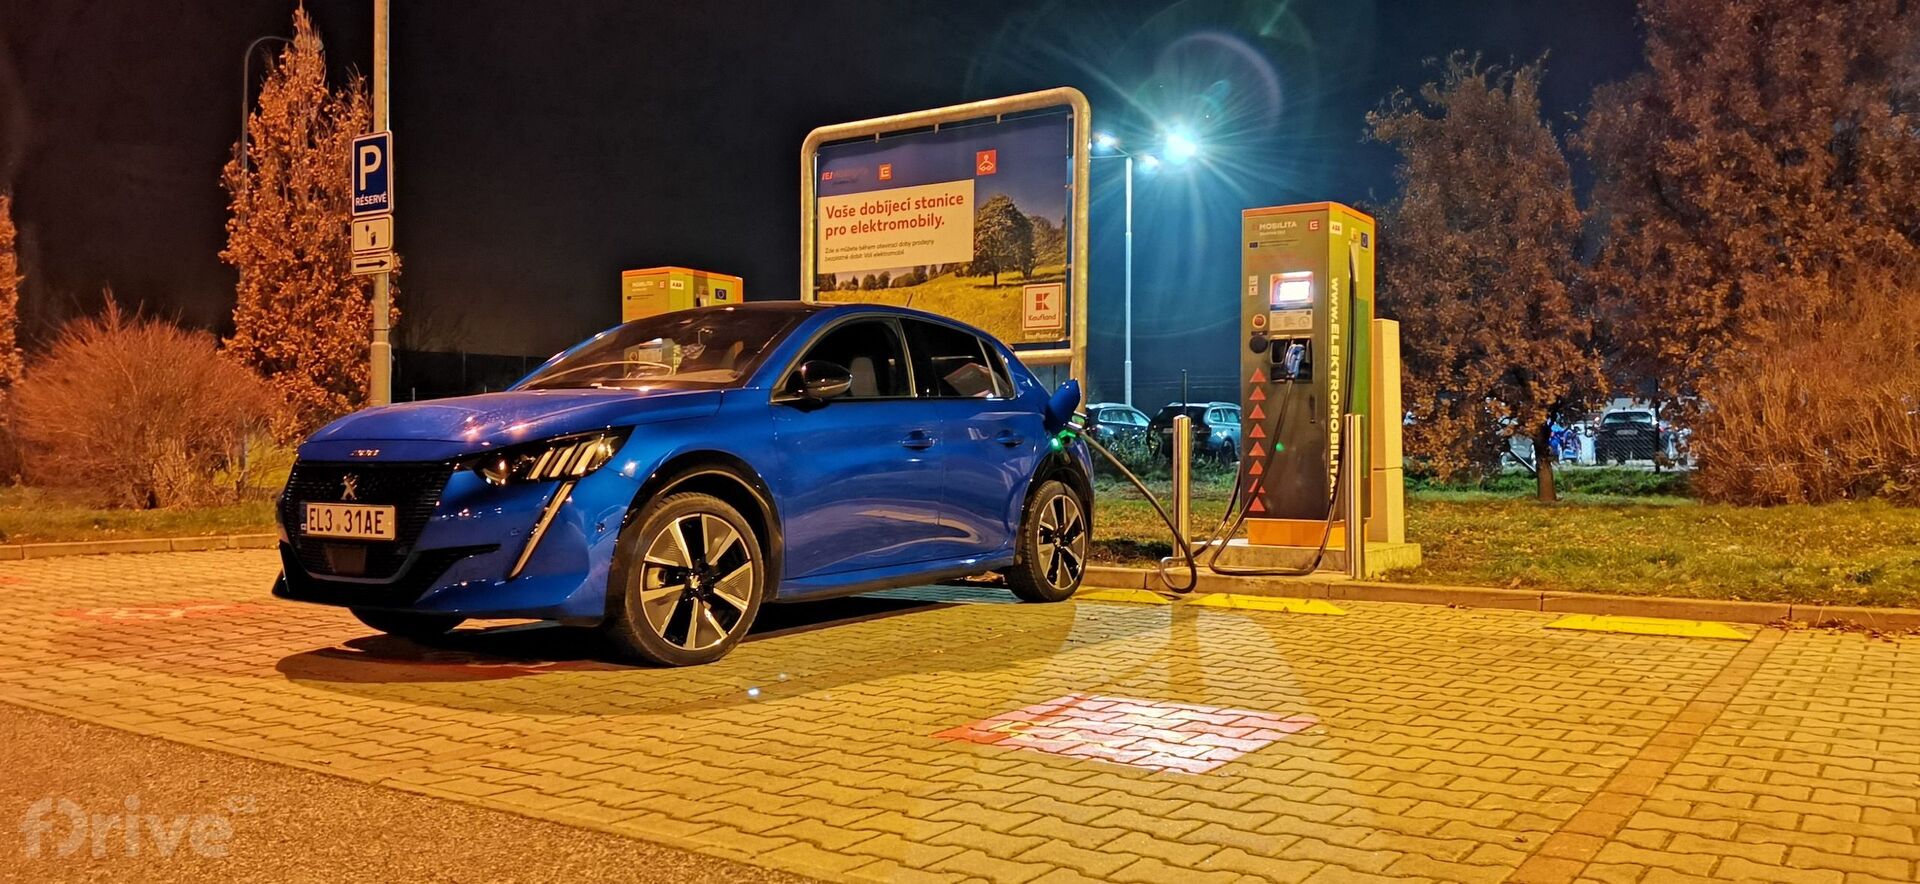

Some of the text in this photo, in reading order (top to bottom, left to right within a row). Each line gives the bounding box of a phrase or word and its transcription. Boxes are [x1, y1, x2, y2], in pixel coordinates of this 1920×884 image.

[360, 144, 382, 191] P
[355, 191, 387, 207] RÉSERVÉ
[825, 193, 964, 219] Vaše dobíjecí stanice
[825, 213, 945, 240] pro elektromobily.
[1028, 313, 1057, 321] Kaufland
[309, 507, 384, 535] EL3 31AE
